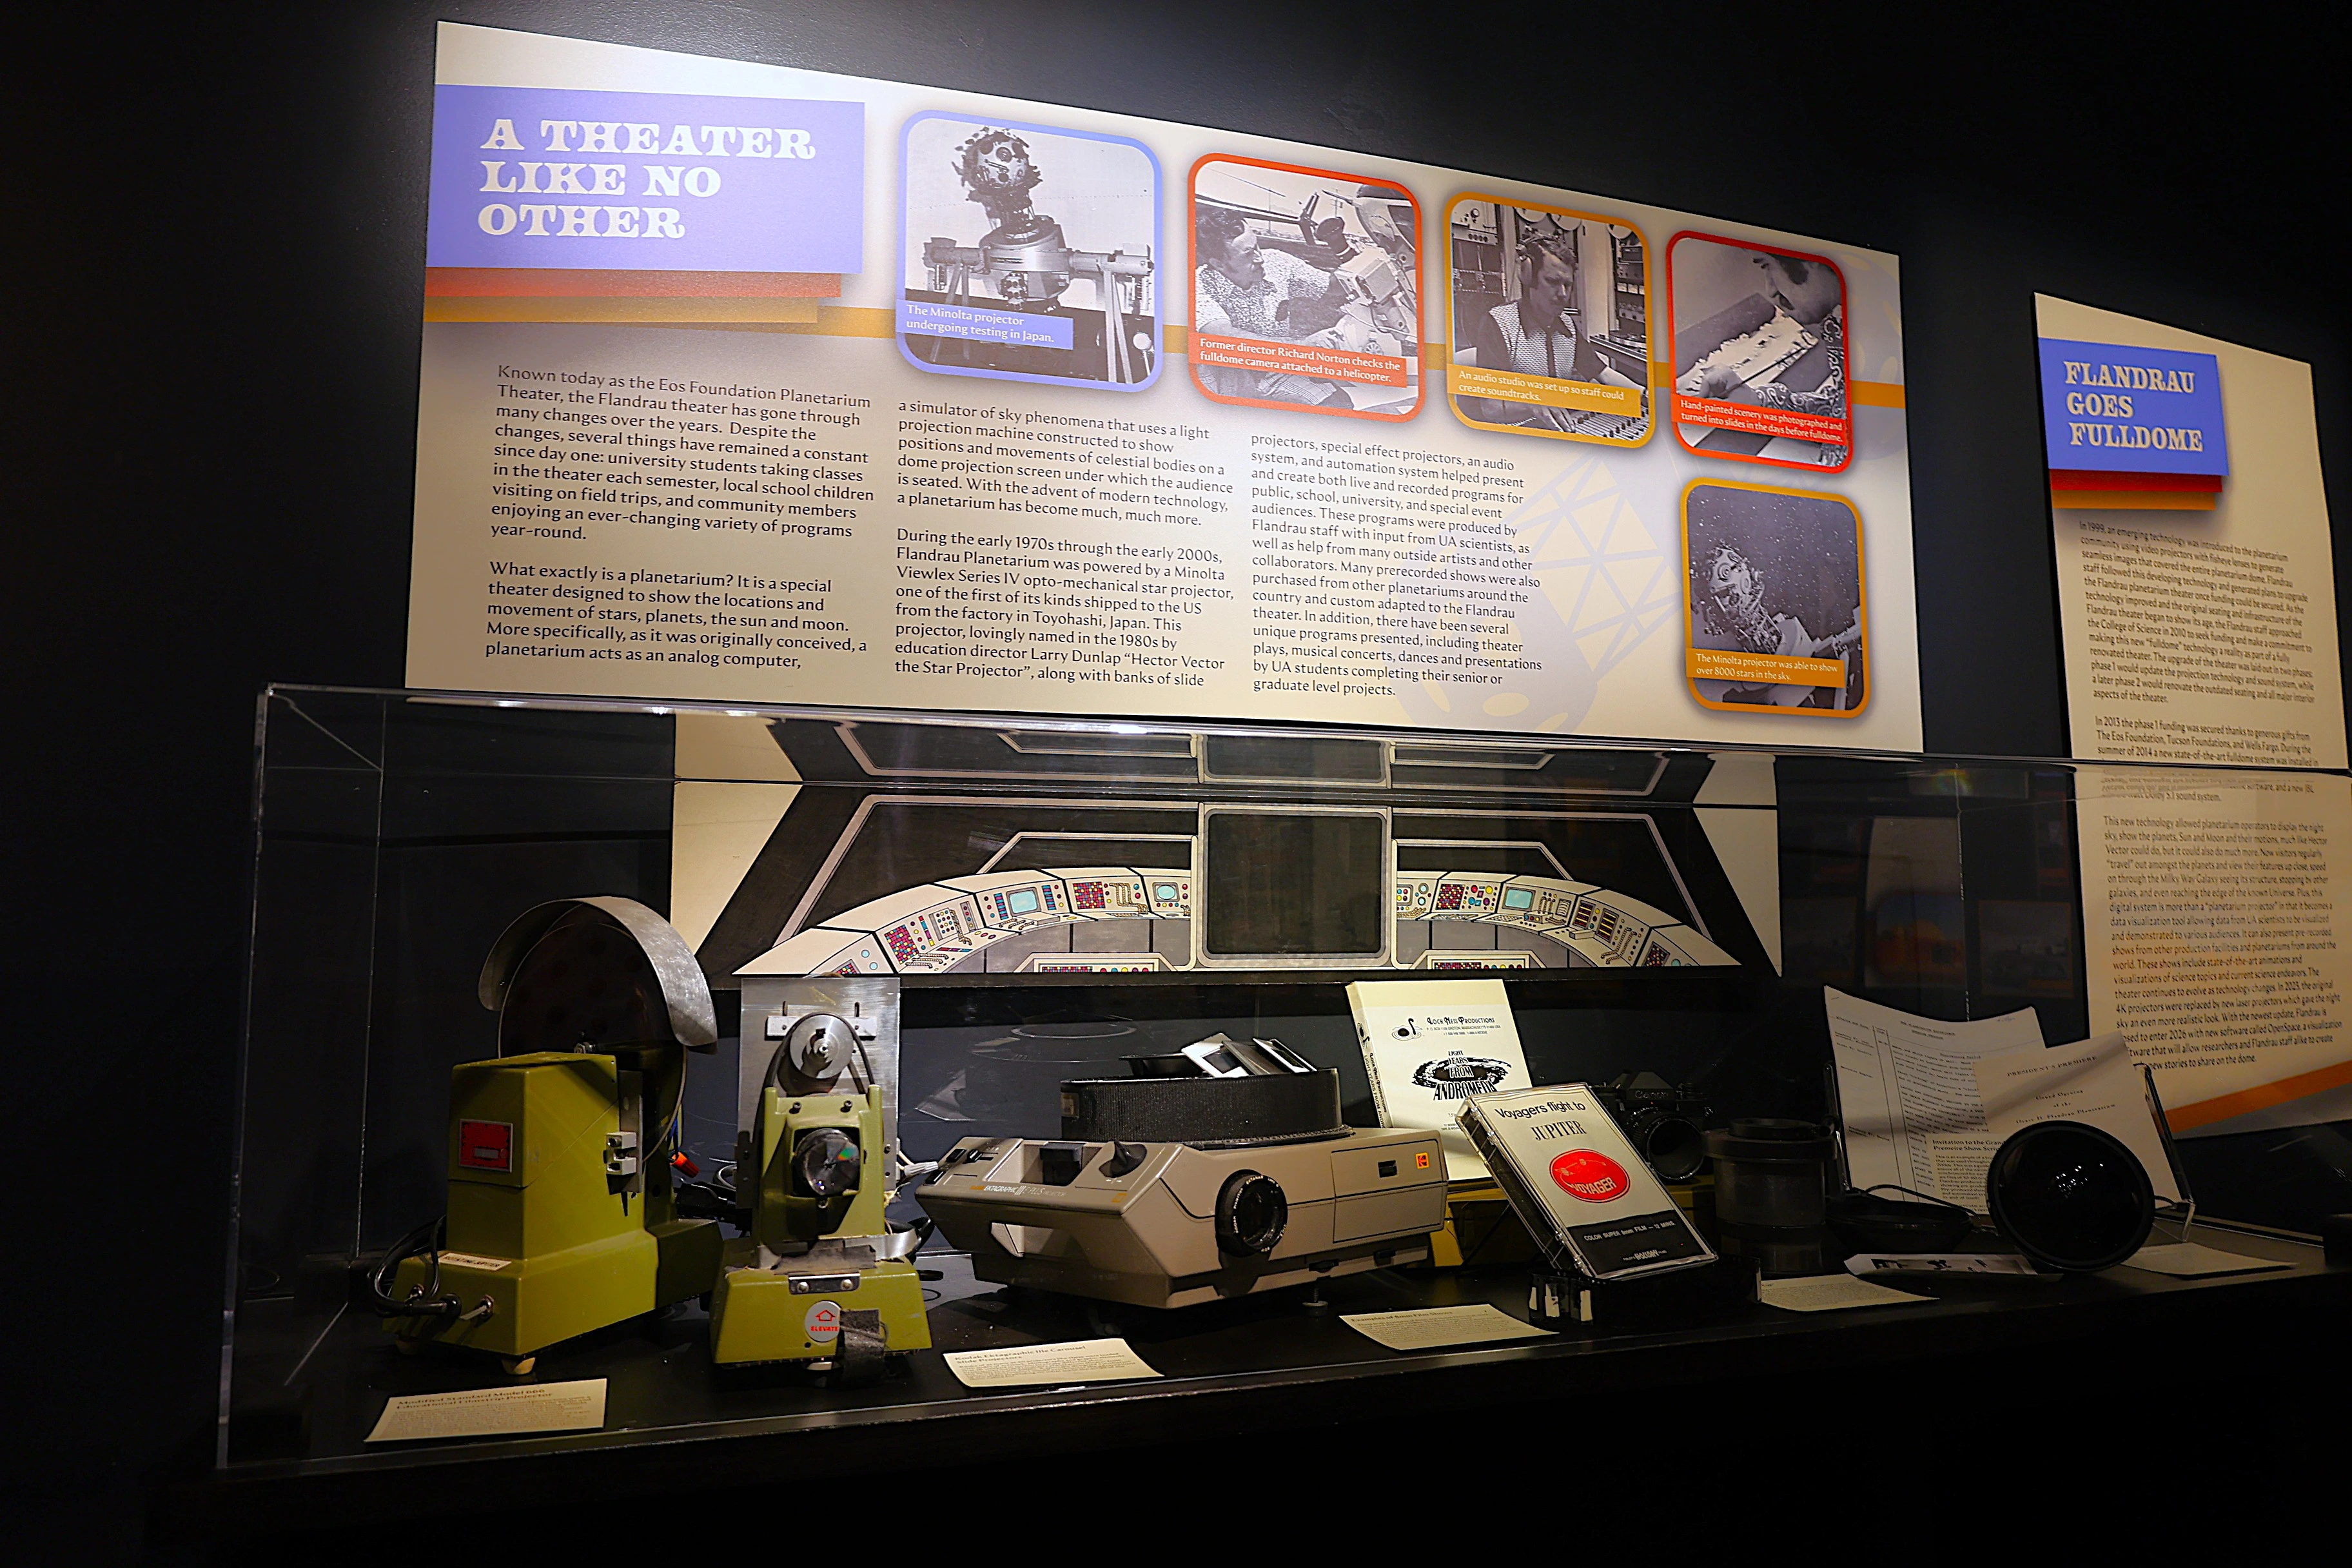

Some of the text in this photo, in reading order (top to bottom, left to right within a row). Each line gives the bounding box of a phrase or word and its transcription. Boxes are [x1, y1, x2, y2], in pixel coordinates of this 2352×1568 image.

[480, 119, 816, 160] A THEATER
[479, 160, 721, 198] LIKE NO
[477, 203, 685, 239] OTHER
[906, 304, 1024, 325] The Minolta projector
[906, 320, 1054, 342] undergoing testing in Japan.
[1200, 338, 1400, 371] Former director Richard Norton checks the
[1200, 351, 1244, 364] fulldome
[1245, 358, 1280, 369] camera
[1281, 362, 1322, 374] attached
[1344, 368, 1391, 382] helicopter.
[498, 365, 870, 407] Known today as the Eos Foundation Planetarium
[1458, 370, 1471, 379] An
[1473, 373, 1497, 383] audio
[1498, 377, 1525, 387] studio
[1527, 381, 1544, 389] was
[1559, 386, 1570, 394] up
[1581, 387, 1601, 397] staff
[1602, 391, 1624, 400] could
[2063, 360, 2196, 393] FLANDRAU
[1458, 384, 1542, 401] create soundtracks.
[2066, 392, 2134, 418] GOES
[1681, 400, 1733, 415] Hand-painted
[1734, 409, 1761, 420] scenery
[1778, 414, 1828, 429] photographed
[1681, 413, 1843, 442] turned into slides in the days before fulldome.
[2068, 422, 2204, 453] FULLDOME
[1251, 435, 1514, 471] projectors, special effect projectors, an audio
[897, 528, 1222, 564] During the early 1970s through the early 2000s,
[1696, 653, 1711, 663] The
[1712, 655, 1742, 665] Minolta
[1743, 658, 1777, 667] projector
[1794, 661, 1809, 670] able
[1819, 663, 1838, 672] show
[1714, 667, 1736, 676] 8000
[1756, 670, 1763, 678] in
[1764, 671, 1777, 680] the
[1778, 672, 1791, 680] sky.
[1253, 679, 1395, 696] graduate level projects.
[2095, 716, 2102, 725] In
[2103, 716, 2121, 727] 2013
[2121, 718, 2133, 729] the
[2134, 718, 2154, 730] phase
[2155, 720, 2158, 729] 1
[2159, 720, 2186, 734] funding
[2200, 725, 2224, 734] secured
[2247, 729, 2254, 737] to
[2116, 1004, 2126, 1014] 4K
[2128, 1003, 2164, 1015] projectors
[2184, 999, 2211, 1012] replaced
[2213, 999, 2220, 1009] by
[2236, 998, 2250, 1007] laser
[2251, 997, 2282, 1008] projectors
[2283, 995, 2300, 1004] which
[2302, 996, 2315, 1006] gave
[2315, 994, 2325, 1003] the
[2326, 993, 2340, 1004] night
[1449, 1066, 1474, 1079] FROM
[1433, 1080, 1498, 1101] ANDROMEDA
[1494, 1101, 1586, 1119] Voyagers flight to
[1530, 1120, 1587, 1141] JUPITER
[1571, 1177, 1617, 1195] VOYAGER
